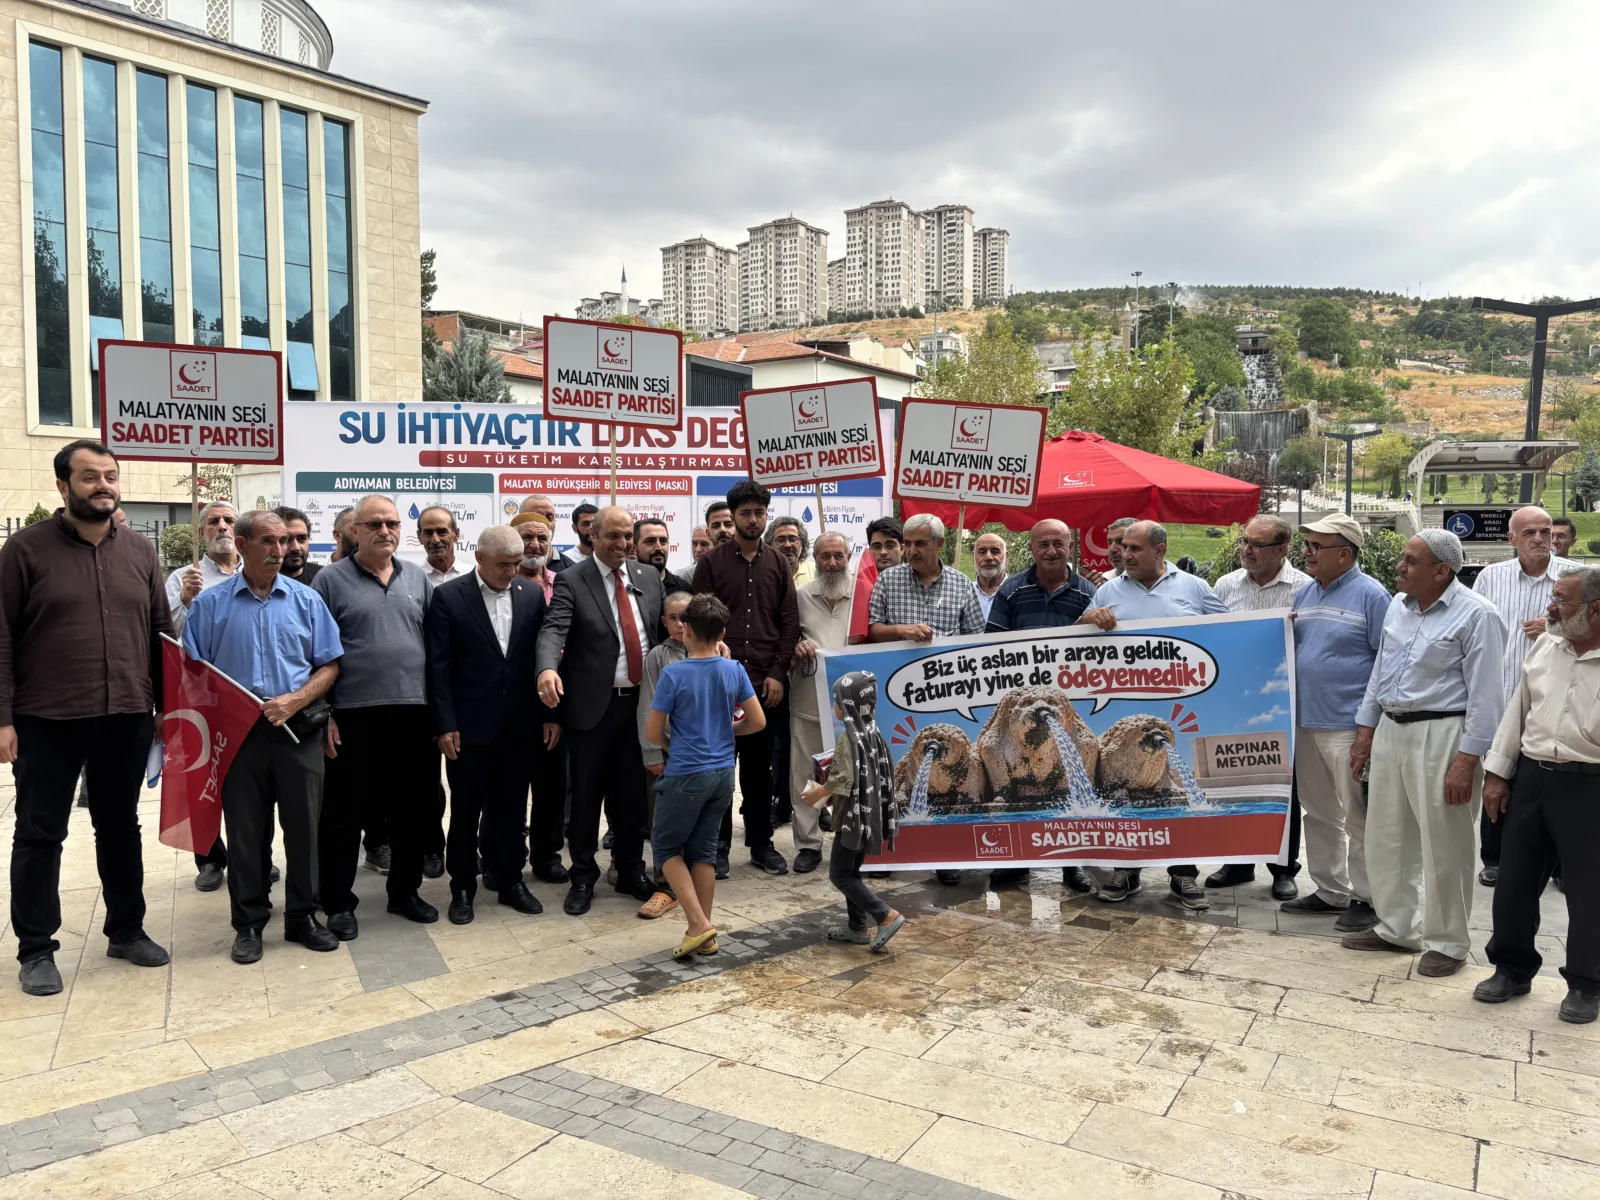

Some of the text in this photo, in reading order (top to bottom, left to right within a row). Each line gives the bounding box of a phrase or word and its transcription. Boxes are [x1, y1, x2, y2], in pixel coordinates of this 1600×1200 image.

[601, 356, 628, 365] SAADET
[176, 384, 212, 393] SAADET
[557, 368, 670, 394] MALATYA'NIN SESİ
[551, 386, 676, 415] SAADET PARTİSİ
[119, 400, 266, 423] MALATYA'NIN SESİ
[797, 416, 824, 425] SAADET
[111, 421, 274, 448] SAADET PARTİSİ
[338, 410, 386, 445] SU
[397, 402, 582, 450] İHTİYAÇTIR
[686, 408, 746, 449] DEĞ
[758, 423, 868, 454] MALATYA'NIN SESİ
[956, 436, 984, 445] SAADET
[446, 452, 743, 470] SU TÜKETİM KARŞILAŞTIRMASI
[755, 440, 877, 475] SAADET PARTİSİ
[909, 449, 1028, 473] MALATYA'NIN SESİ
[334, 475, 457, 490] ADIYAMAN BELEDİYESİ
[503, 478, 543, 489] MALATYA
[546, 476, 601, 492] BÜYÜKŞEHİR
[655, 478, 688, 492] (MASKİ)
[901, 467, 1032, 496] SAADET PARTİSİ
[1083, 558, 1108, 567] SAA
[922, 640, 1188, 681] Biz üç aslan bir araya geldik,
[902, 677, 981, 706] faturayı
[984, 670, 1025, 696] yine
[1029, 666, 1053, 686] de
[1057, 662, 1207, 690] ödeyemedik!
[1214, 740, 1280, 755] AKPINAR
[1216, 754, 1282, 768] MEYDANI
[1044, 819, 1141, 830] MALATYA'NIN SESİ
[1031, 826, 1171, 847] SAADET PARTİSİ
[980, 846, 1009, 855] SAADET
